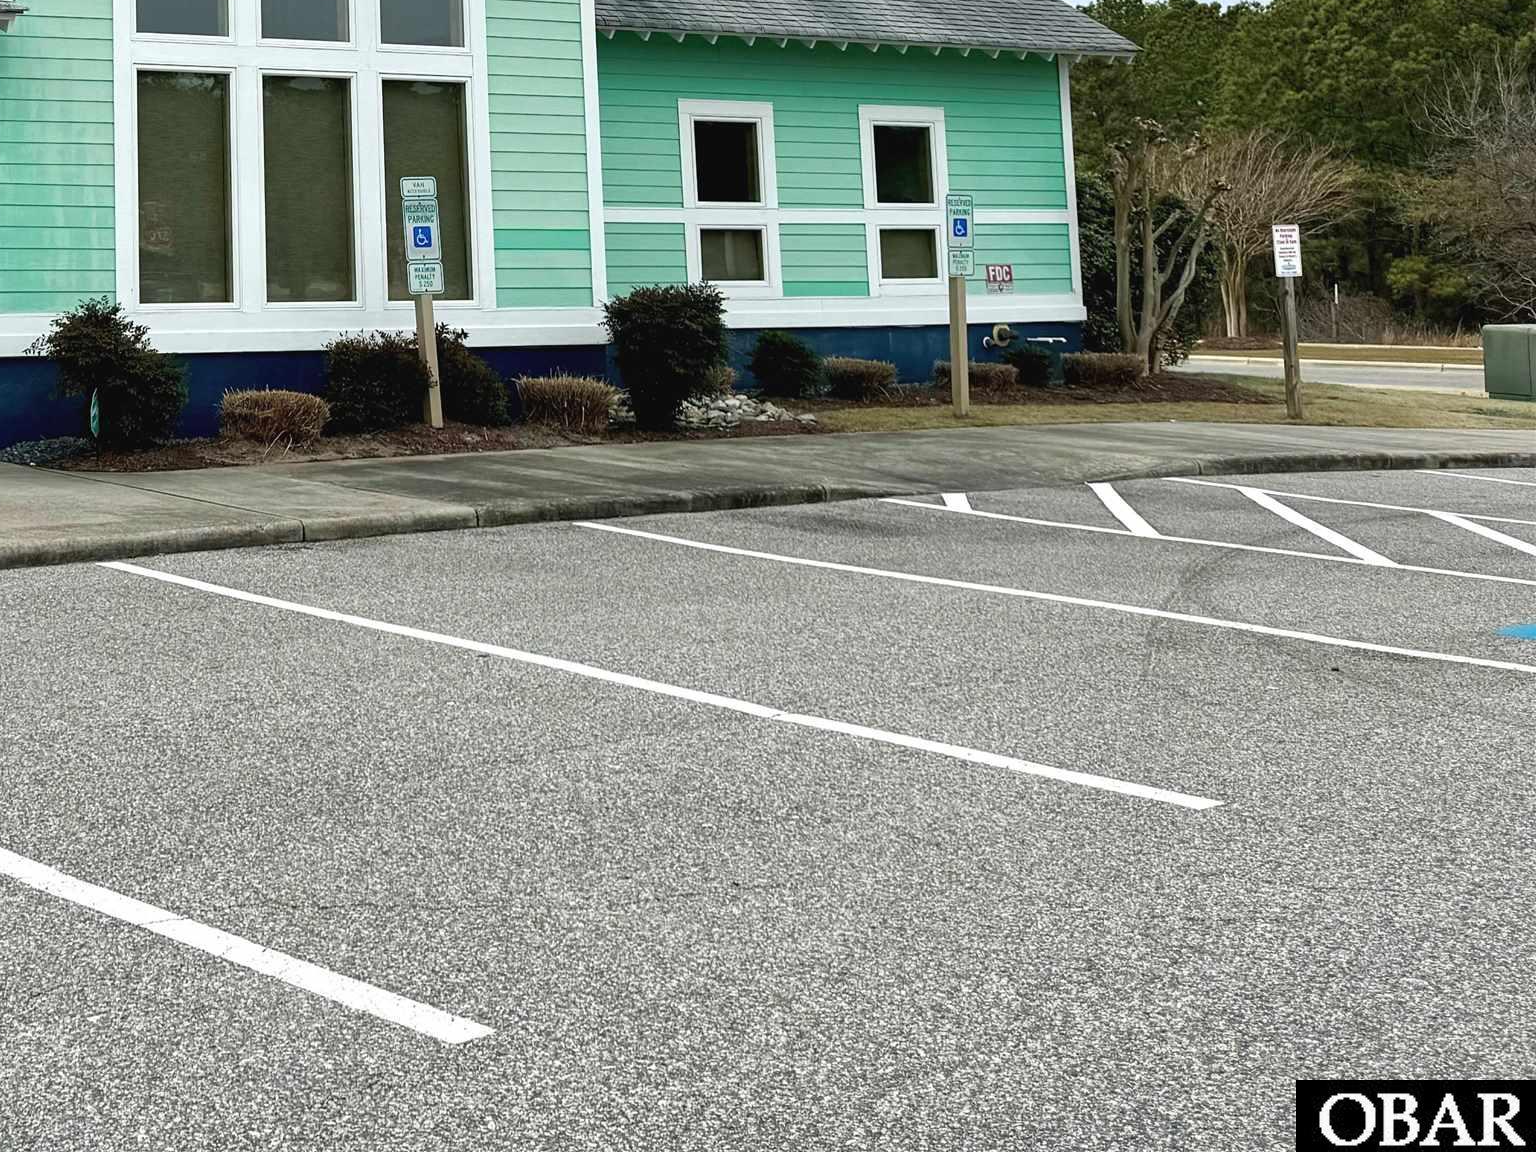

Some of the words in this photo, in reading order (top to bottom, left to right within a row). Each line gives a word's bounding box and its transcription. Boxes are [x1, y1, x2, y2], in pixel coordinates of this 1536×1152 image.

[405, 204, 436, 213] RESERVED
[949, 208, 971, 216] PARKING
[407, 215, 435, 224] PARKING
[988, 266, 1011, 281] FDC
